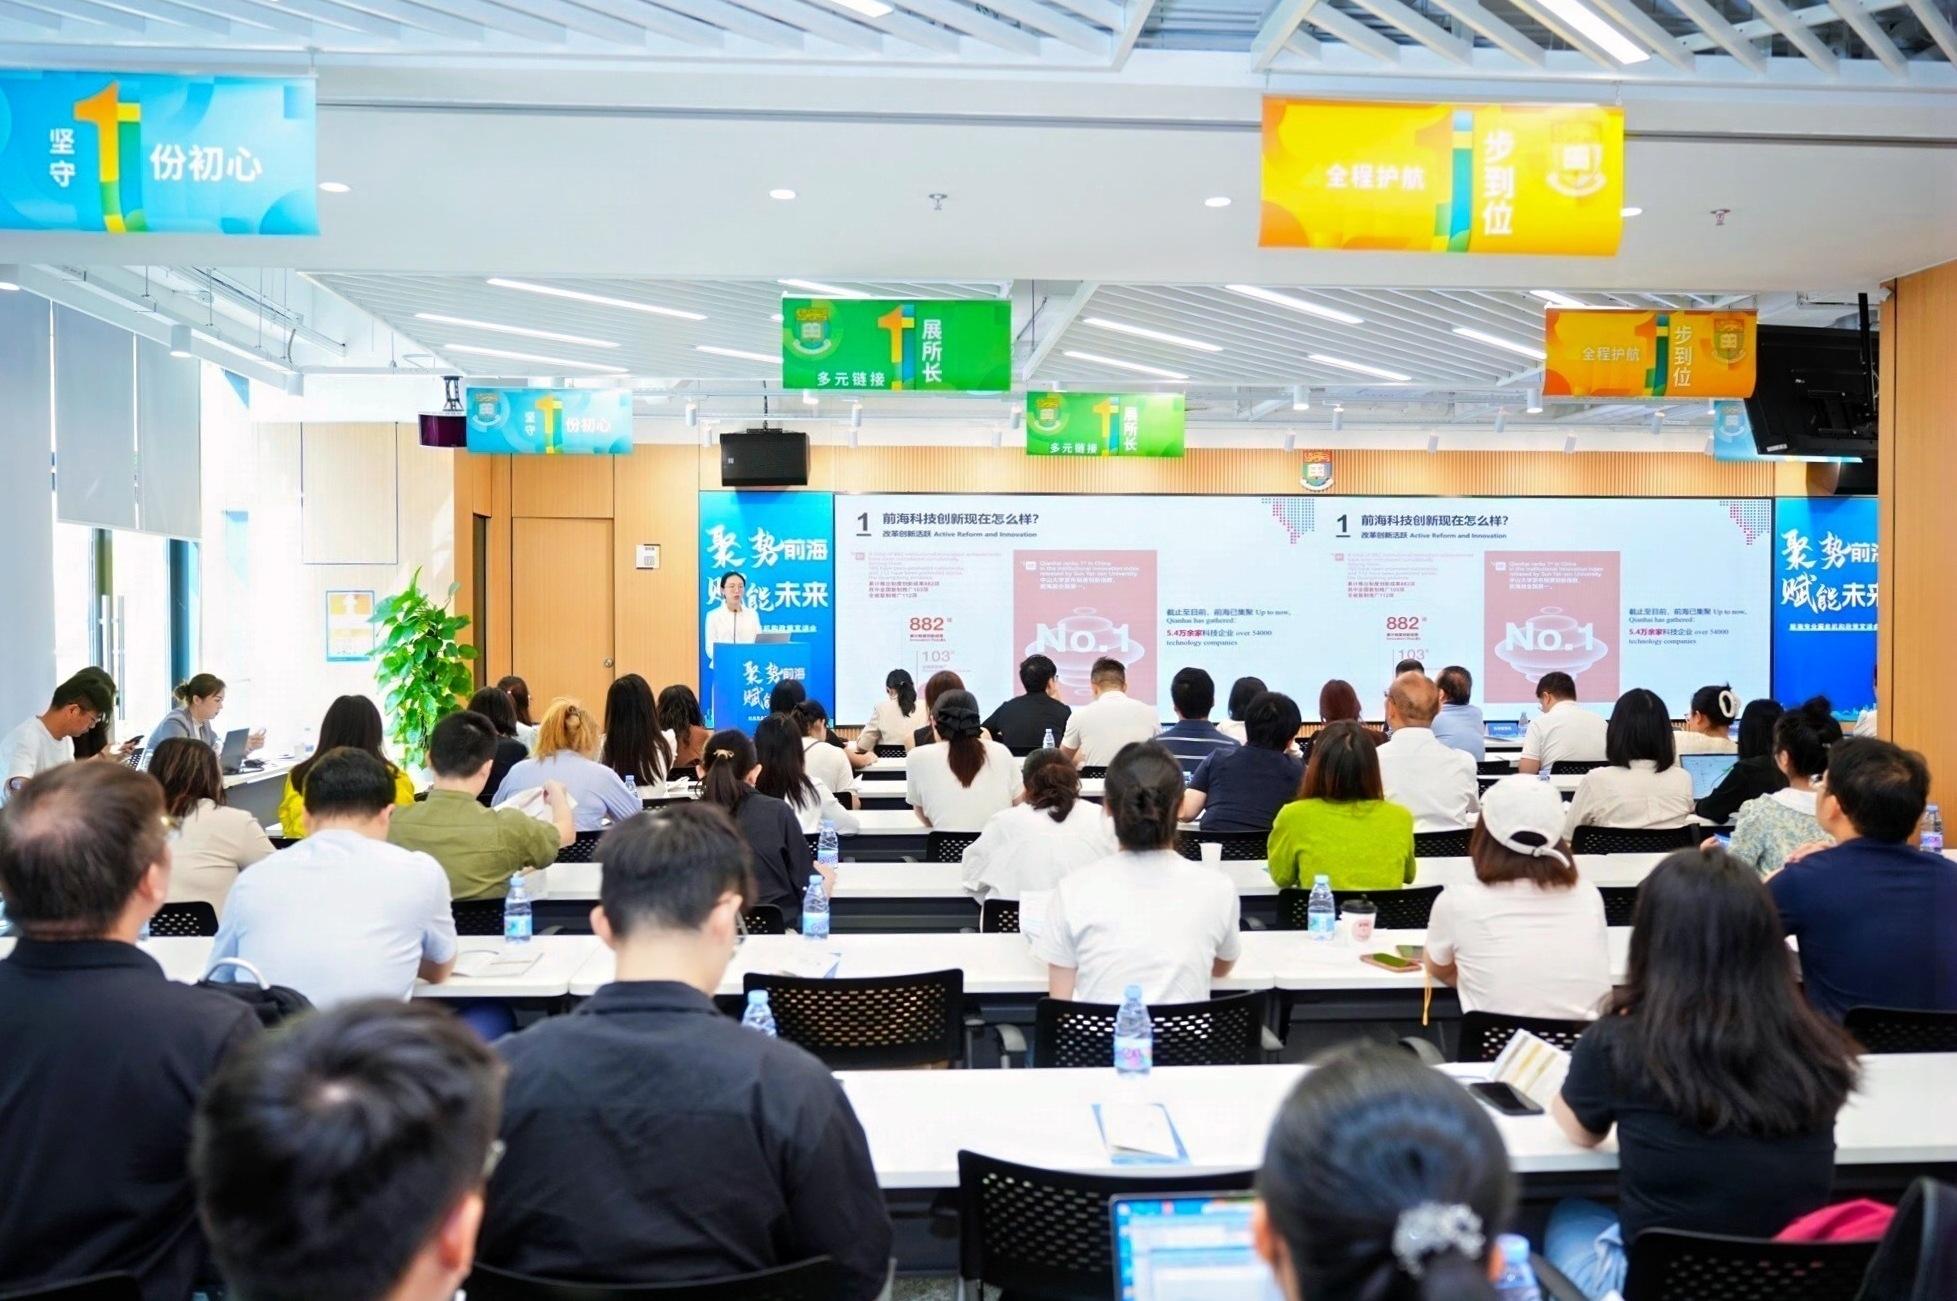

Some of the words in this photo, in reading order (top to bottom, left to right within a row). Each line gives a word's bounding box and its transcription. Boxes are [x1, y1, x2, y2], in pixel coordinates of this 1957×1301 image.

[50, 128, 75, 187] 坚守
[151, 143, 263, 182] 份初心
[1326, 163, 1426, 191] 全程护航
[1482, 129, 1515, 235] 步到位
[921, 319, 943, 383] 展所长
[1583, 347, 1640, 361] 全程护航
[1673, 326, 1693, 387] 步到位
[817, 372, 885, 387] 多元链接
[566, 417, 611, 433] 份初心
[1124, 406, 1138, 451] 展所长
[1050, 443, 1098, 454] 多元链接
[857, 512, 869, 532] 1
[1336, 514, 1347, 533] 1
[882, 530, 932, 538] 改革创新活跃
[1361, 531, 1408, 539] 改革创新活跃
[705, 524, 828, 569] 聚势前海
[1256, 609, 1266, 617] Up
[1713, 608, 1723, 616] Up
[909, 617, 944, 631] 882
[1386, 617, 1420, 630] 882
[1036, 623, 1130, 653] No.1
[1166, 629, 1234, 637] 5.4万余家科技企业
[1506, 622, 1594, 651] No.1
[1628, 628, 1693, 636] 5.4万余家科技企业
[922, 650, 950, 662] 103
[1399, 649, 1425, 661] 103
[743, 660, 805, 685] 聚势前海
